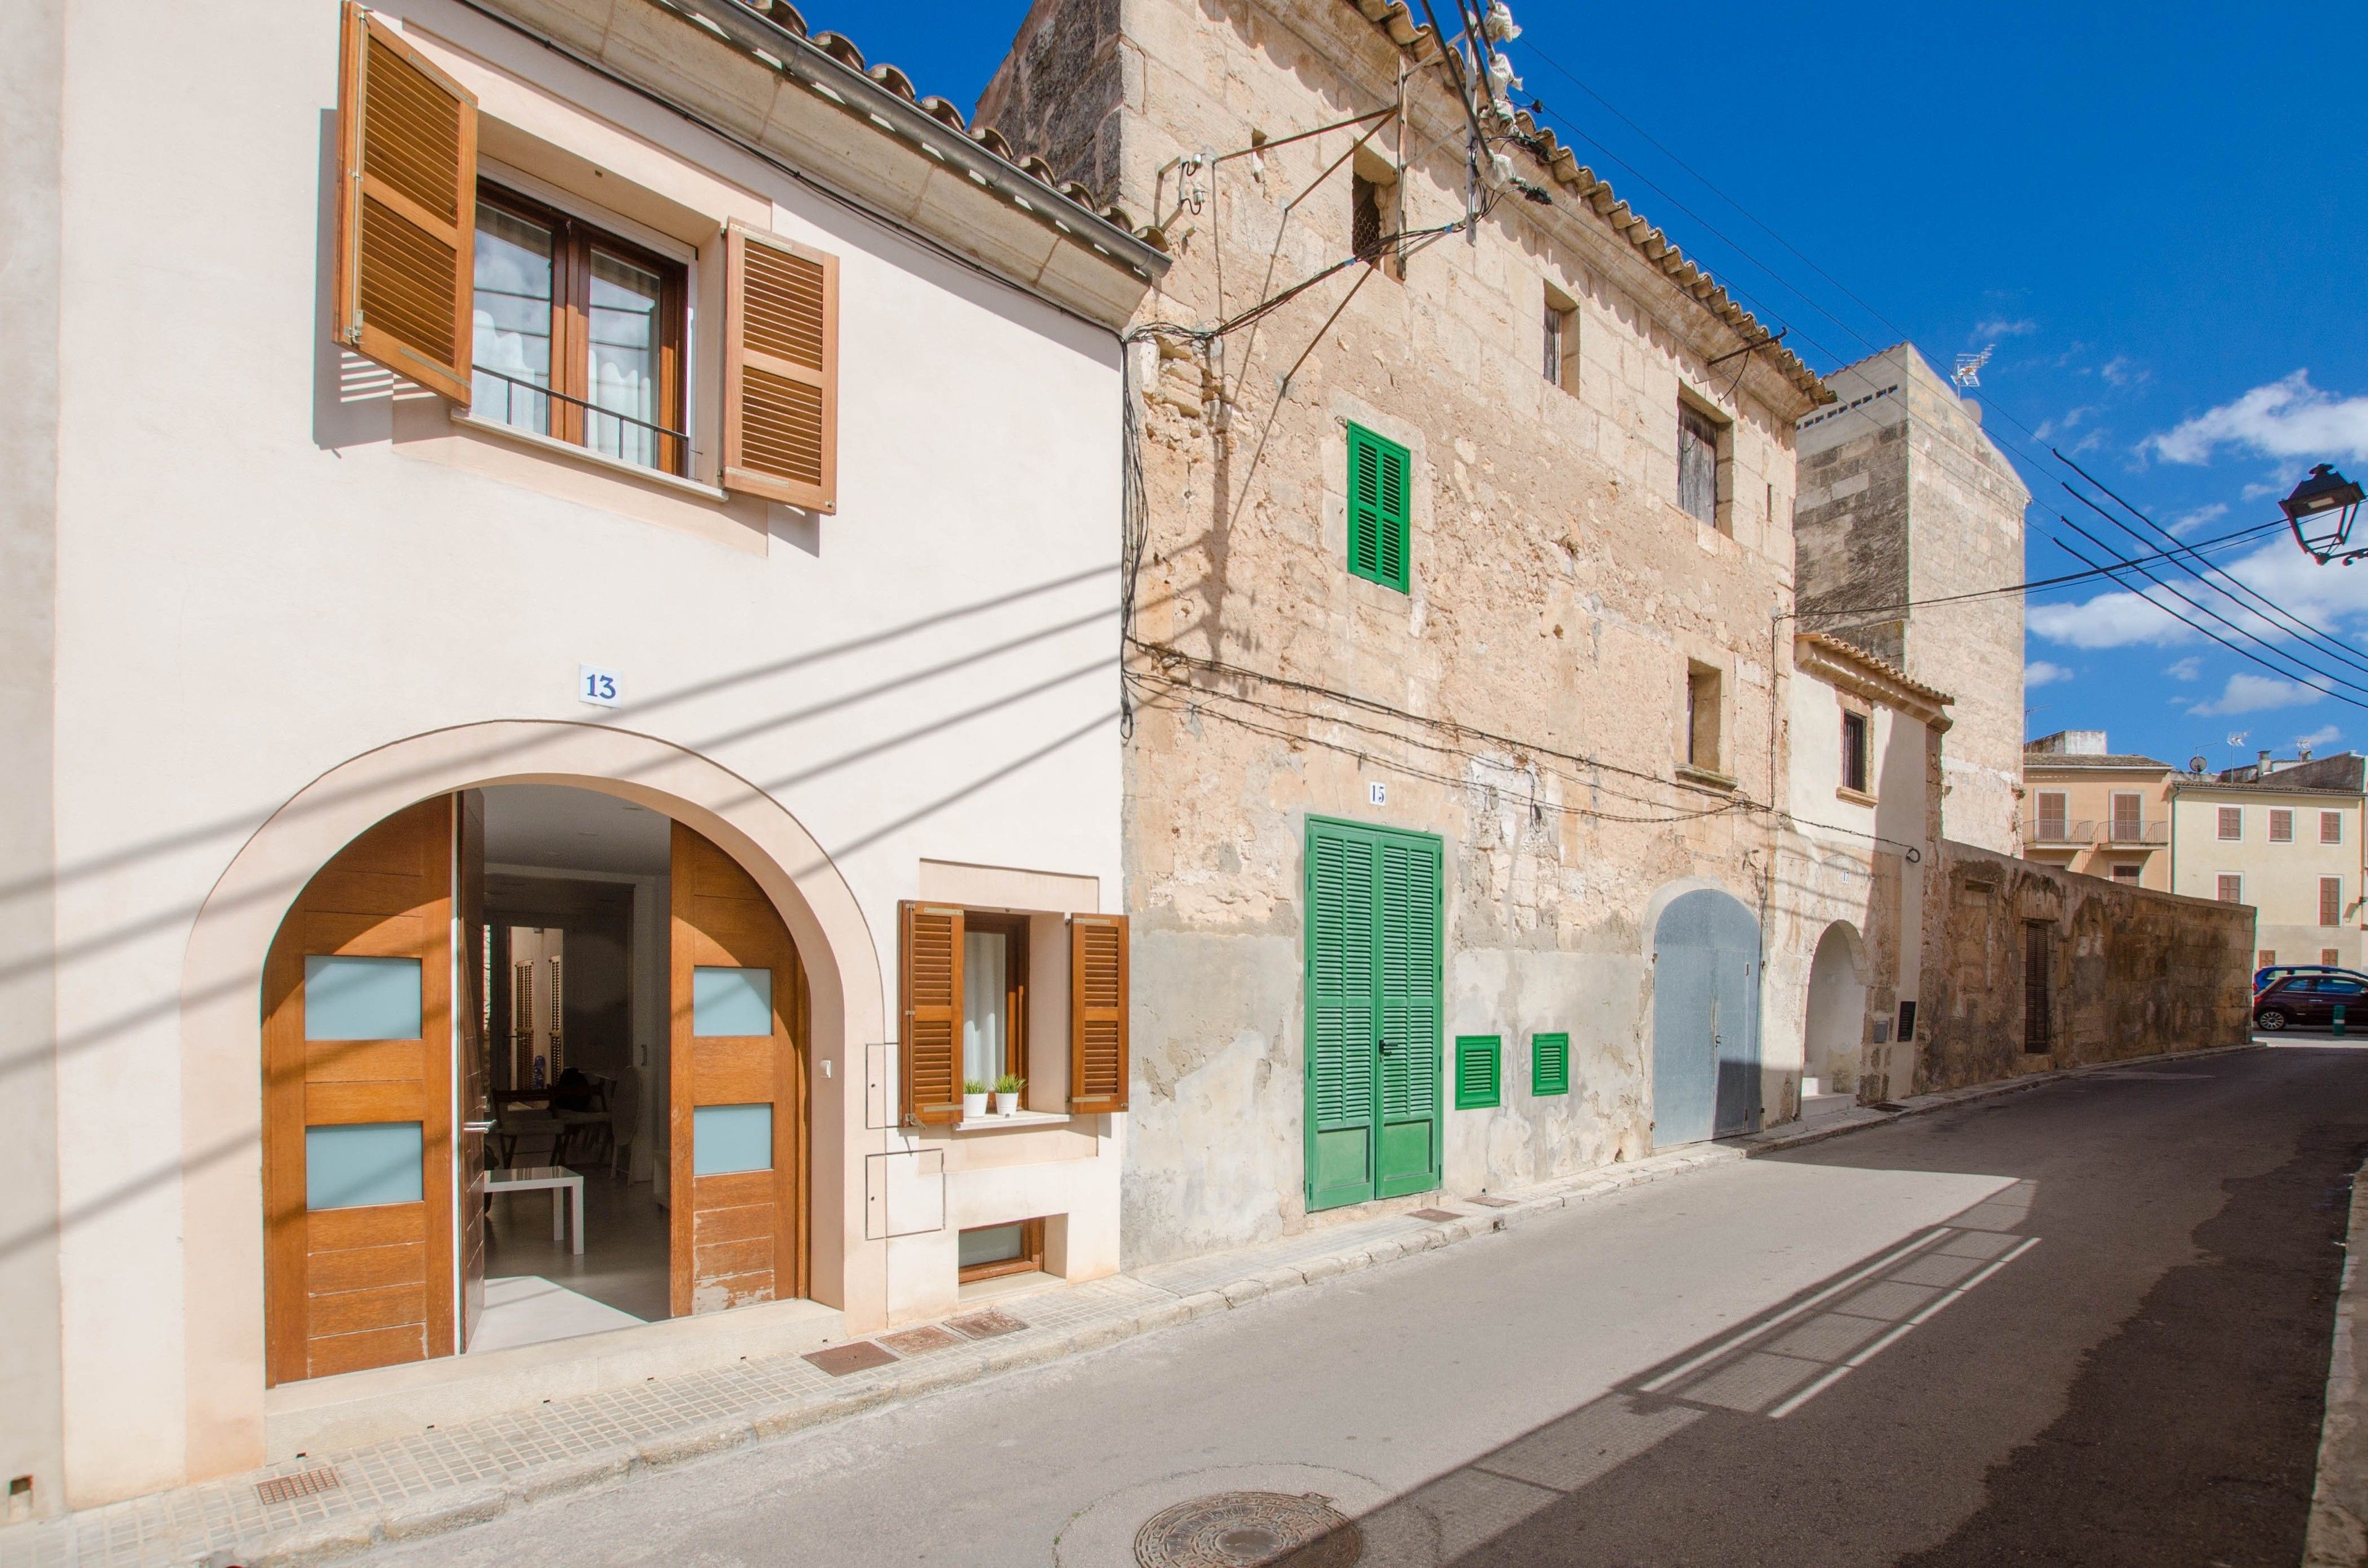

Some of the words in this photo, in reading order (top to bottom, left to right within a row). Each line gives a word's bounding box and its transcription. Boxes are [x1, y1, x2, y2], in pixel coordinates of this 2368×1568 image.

[586, 674, 616, 699] 13
[1373, 785, 1384, 803] 15
[1843, 871, 1849, 882] 17
